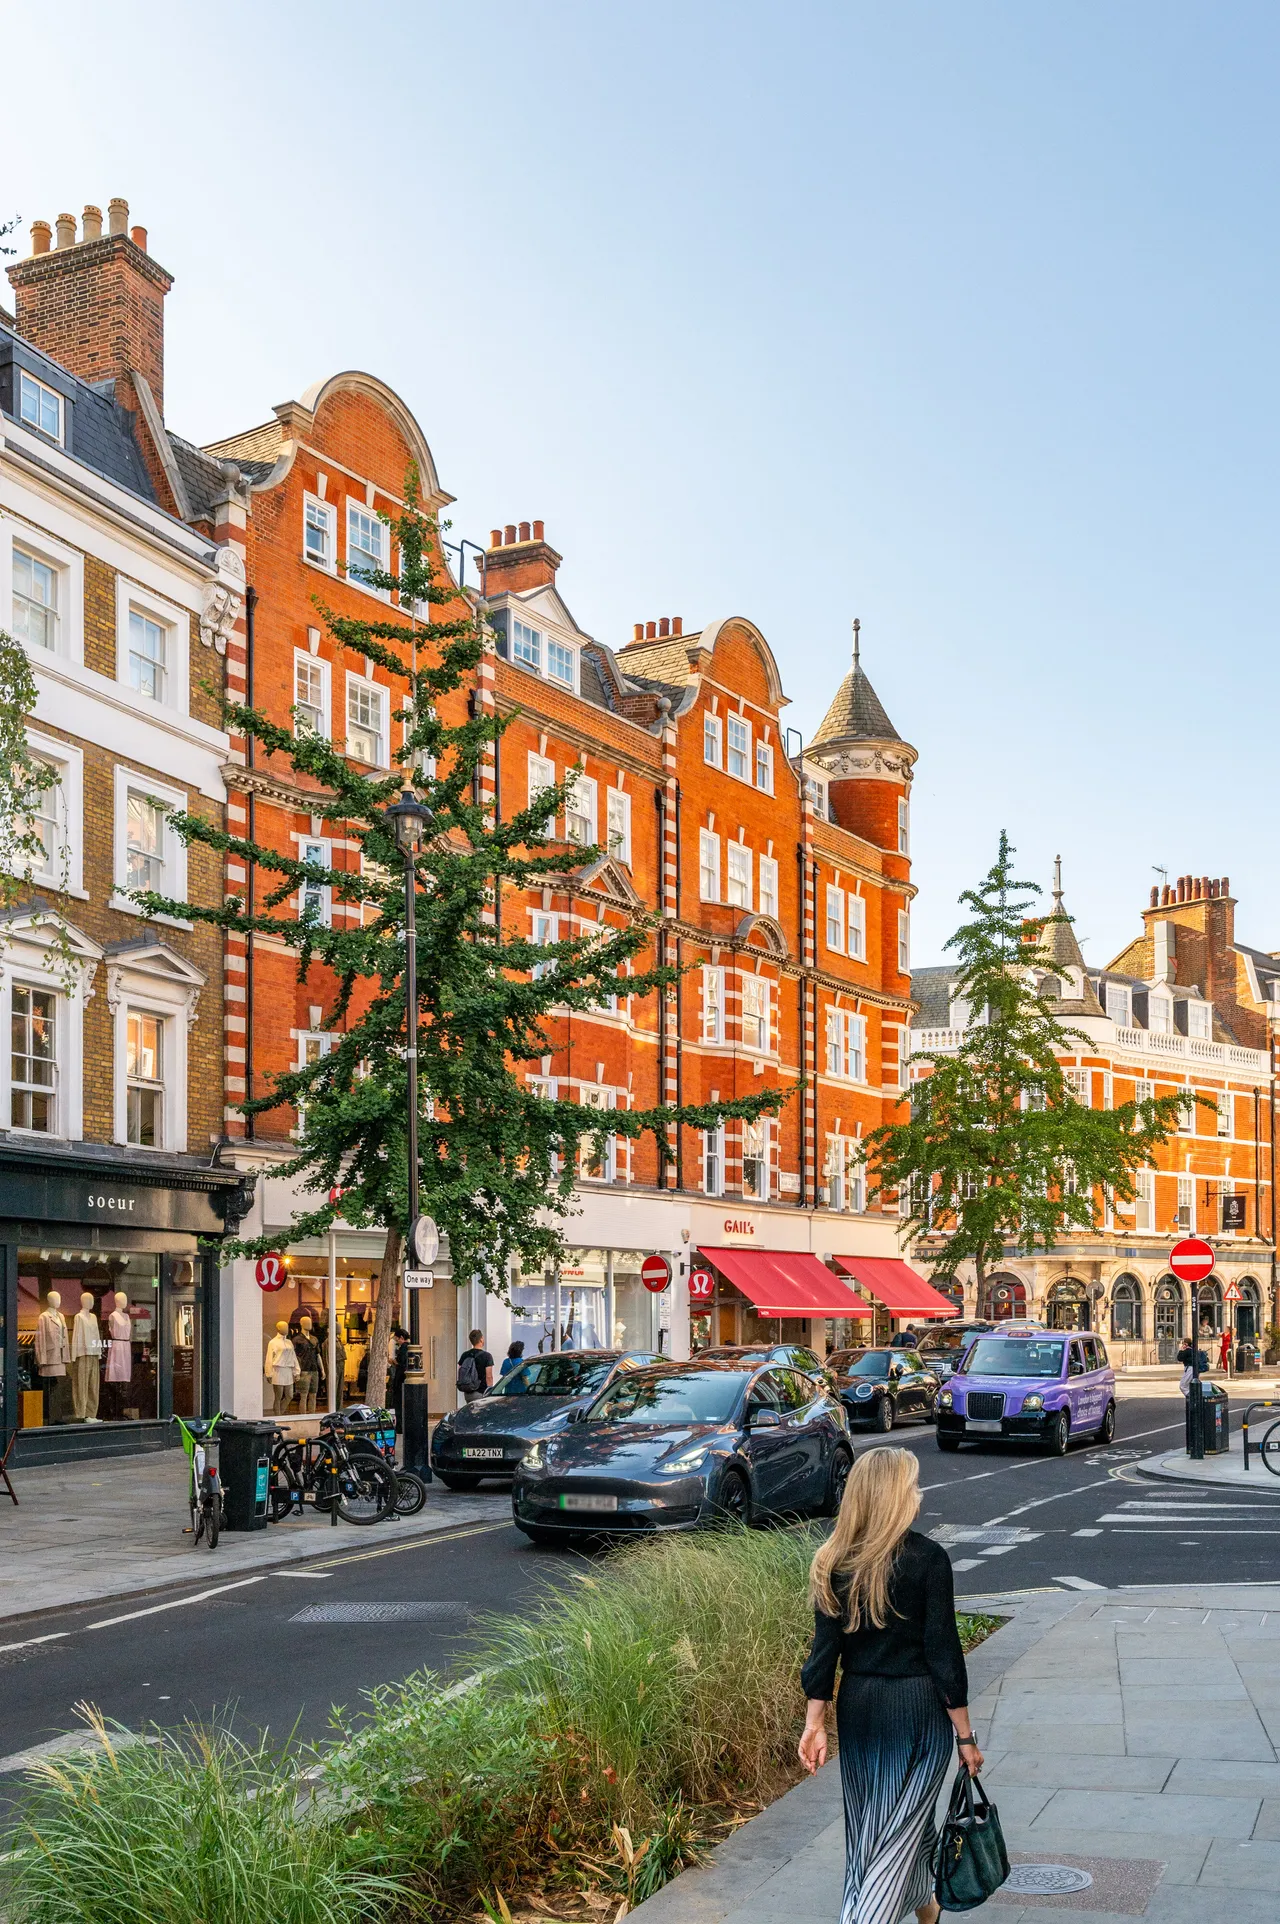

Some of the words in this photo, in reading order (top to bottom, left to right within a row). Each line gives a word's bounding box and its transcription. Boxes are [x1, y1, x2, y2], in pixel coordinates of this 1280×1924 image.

[88, 1195, 135, 1211] soeur
[724, 1219, 755, 1235] GAIL's
[407, 1275, 418, 1283] One
[92, 1339, 112, 1348] SALE
[467, 1448, 486, 1457] LA22
[488, 1448, 502, 1457] TNX
